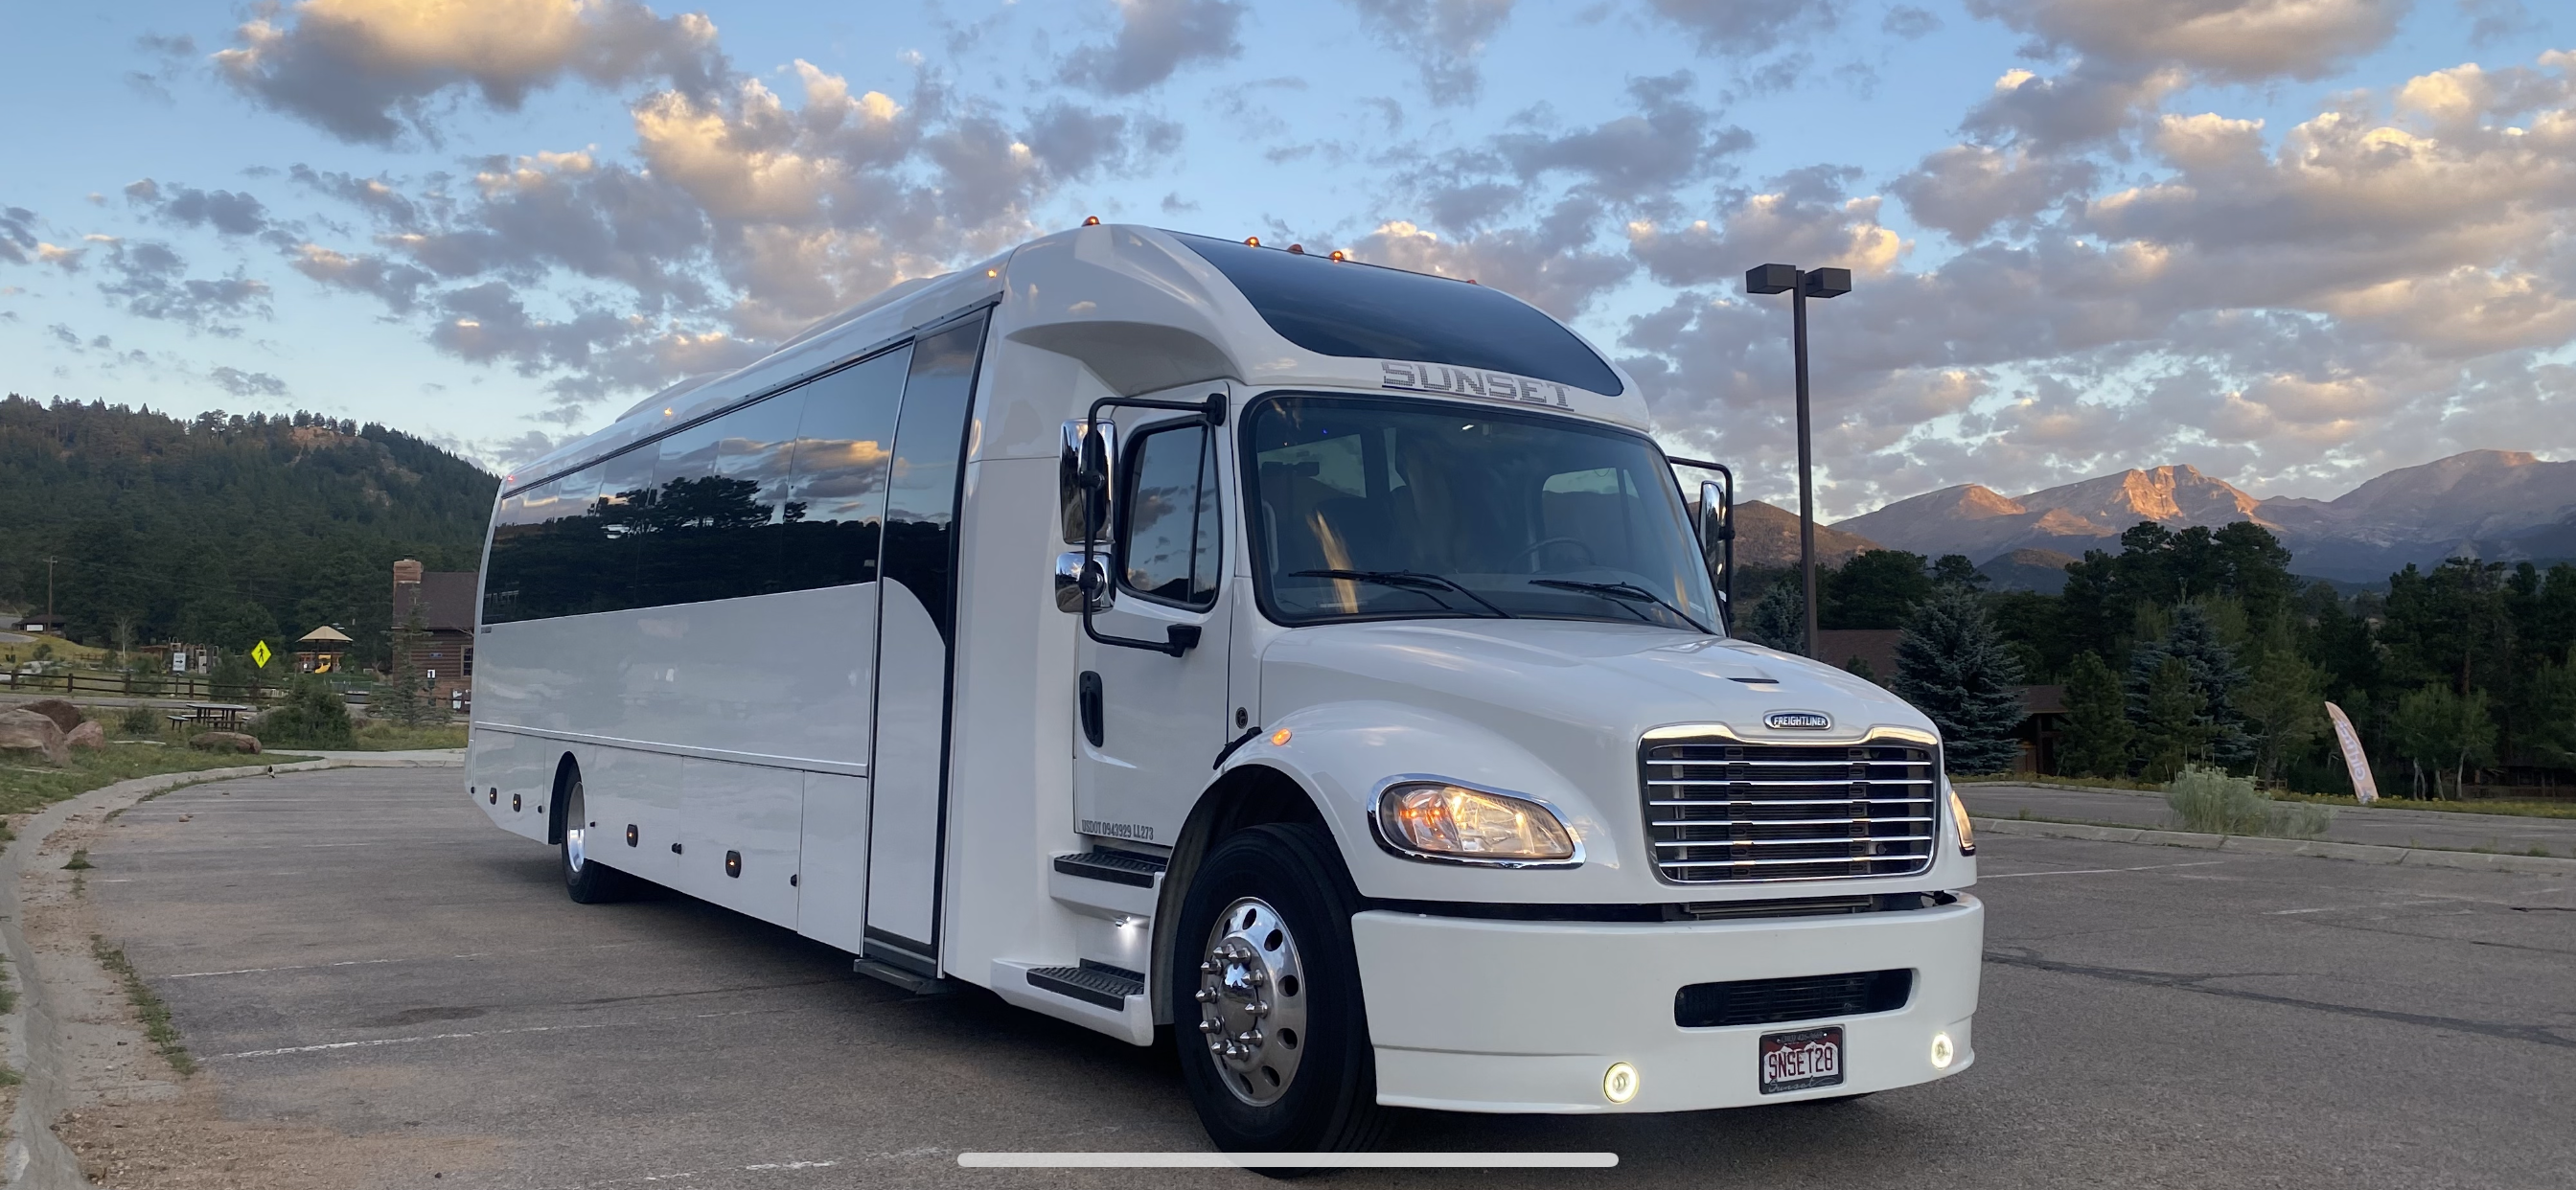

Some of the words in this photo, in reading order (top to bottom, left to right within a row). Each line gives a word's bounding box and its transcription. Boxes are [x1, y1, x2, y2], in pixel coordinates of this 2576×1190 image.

[1381, 360, 1570, 407] SUNSET
[1773, 716, 1827, 726] FREIGHTLINER
[1081, 819, 1101, 835] USDOT
[1102, 822, 1131, 838] 0943929
[1133, 824, 1154, 840] LL273
[1768, 1046, 1833, 1079] SNSET28
[1768, 1075, 1819, 1093] Sunset
